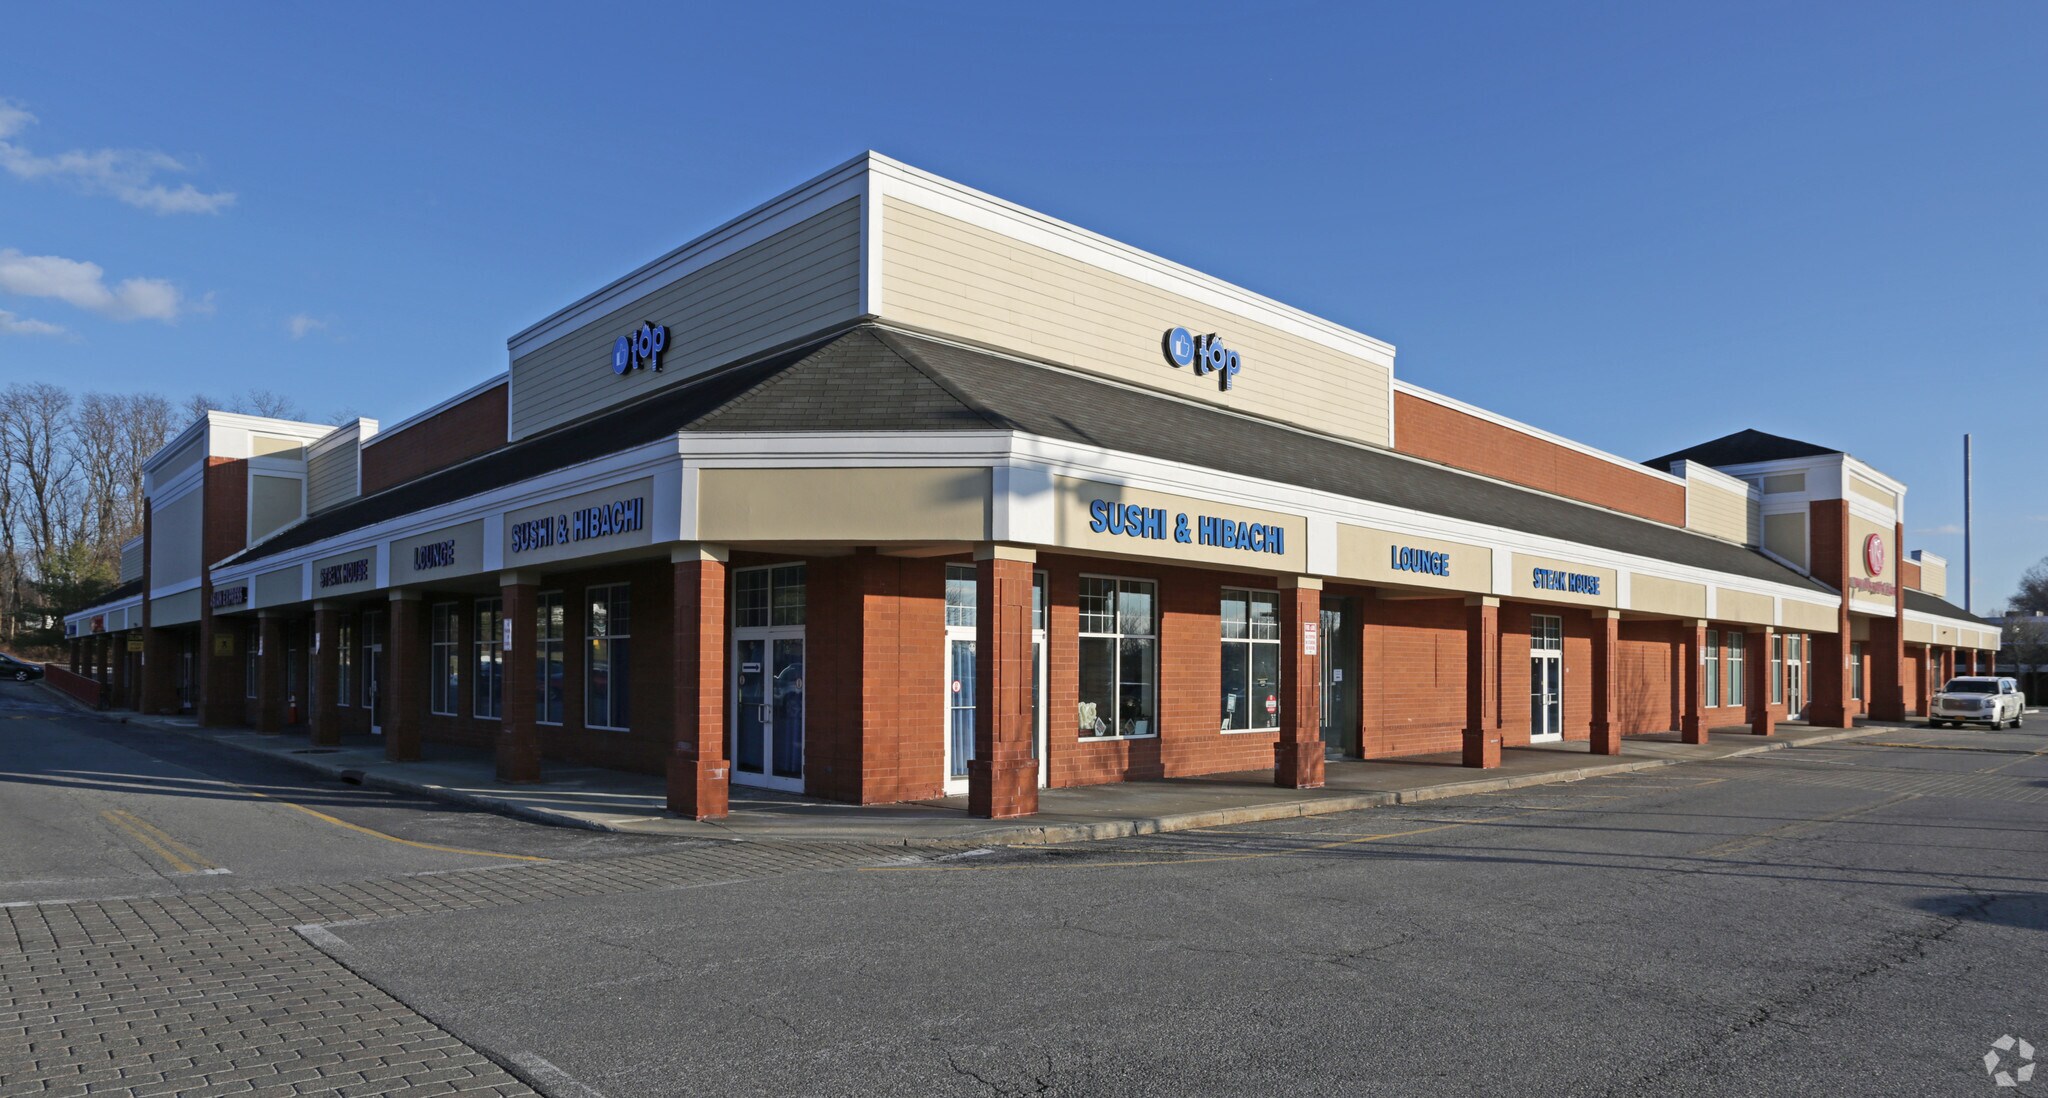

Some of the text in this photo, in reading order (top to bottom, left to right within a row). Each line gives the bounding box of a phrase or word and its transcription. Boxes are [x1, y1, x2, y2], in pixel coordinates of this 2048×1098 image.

[631, 320, 669, 372] top
[1195, 333, 1242, 391] top
[512, 497, 643, 553] SUSHI & HIBACHI
[1089, 499, 1285, 555] SUSHI & HIBACHI
[320, 559, 368, 588] STEAK HOUSE
[414, 540, 455, 571] LOUNGE
[1391, 545, 1450, 577] LOUNGE
[1533, 567, 1601, 596] STEAK HOUSE
